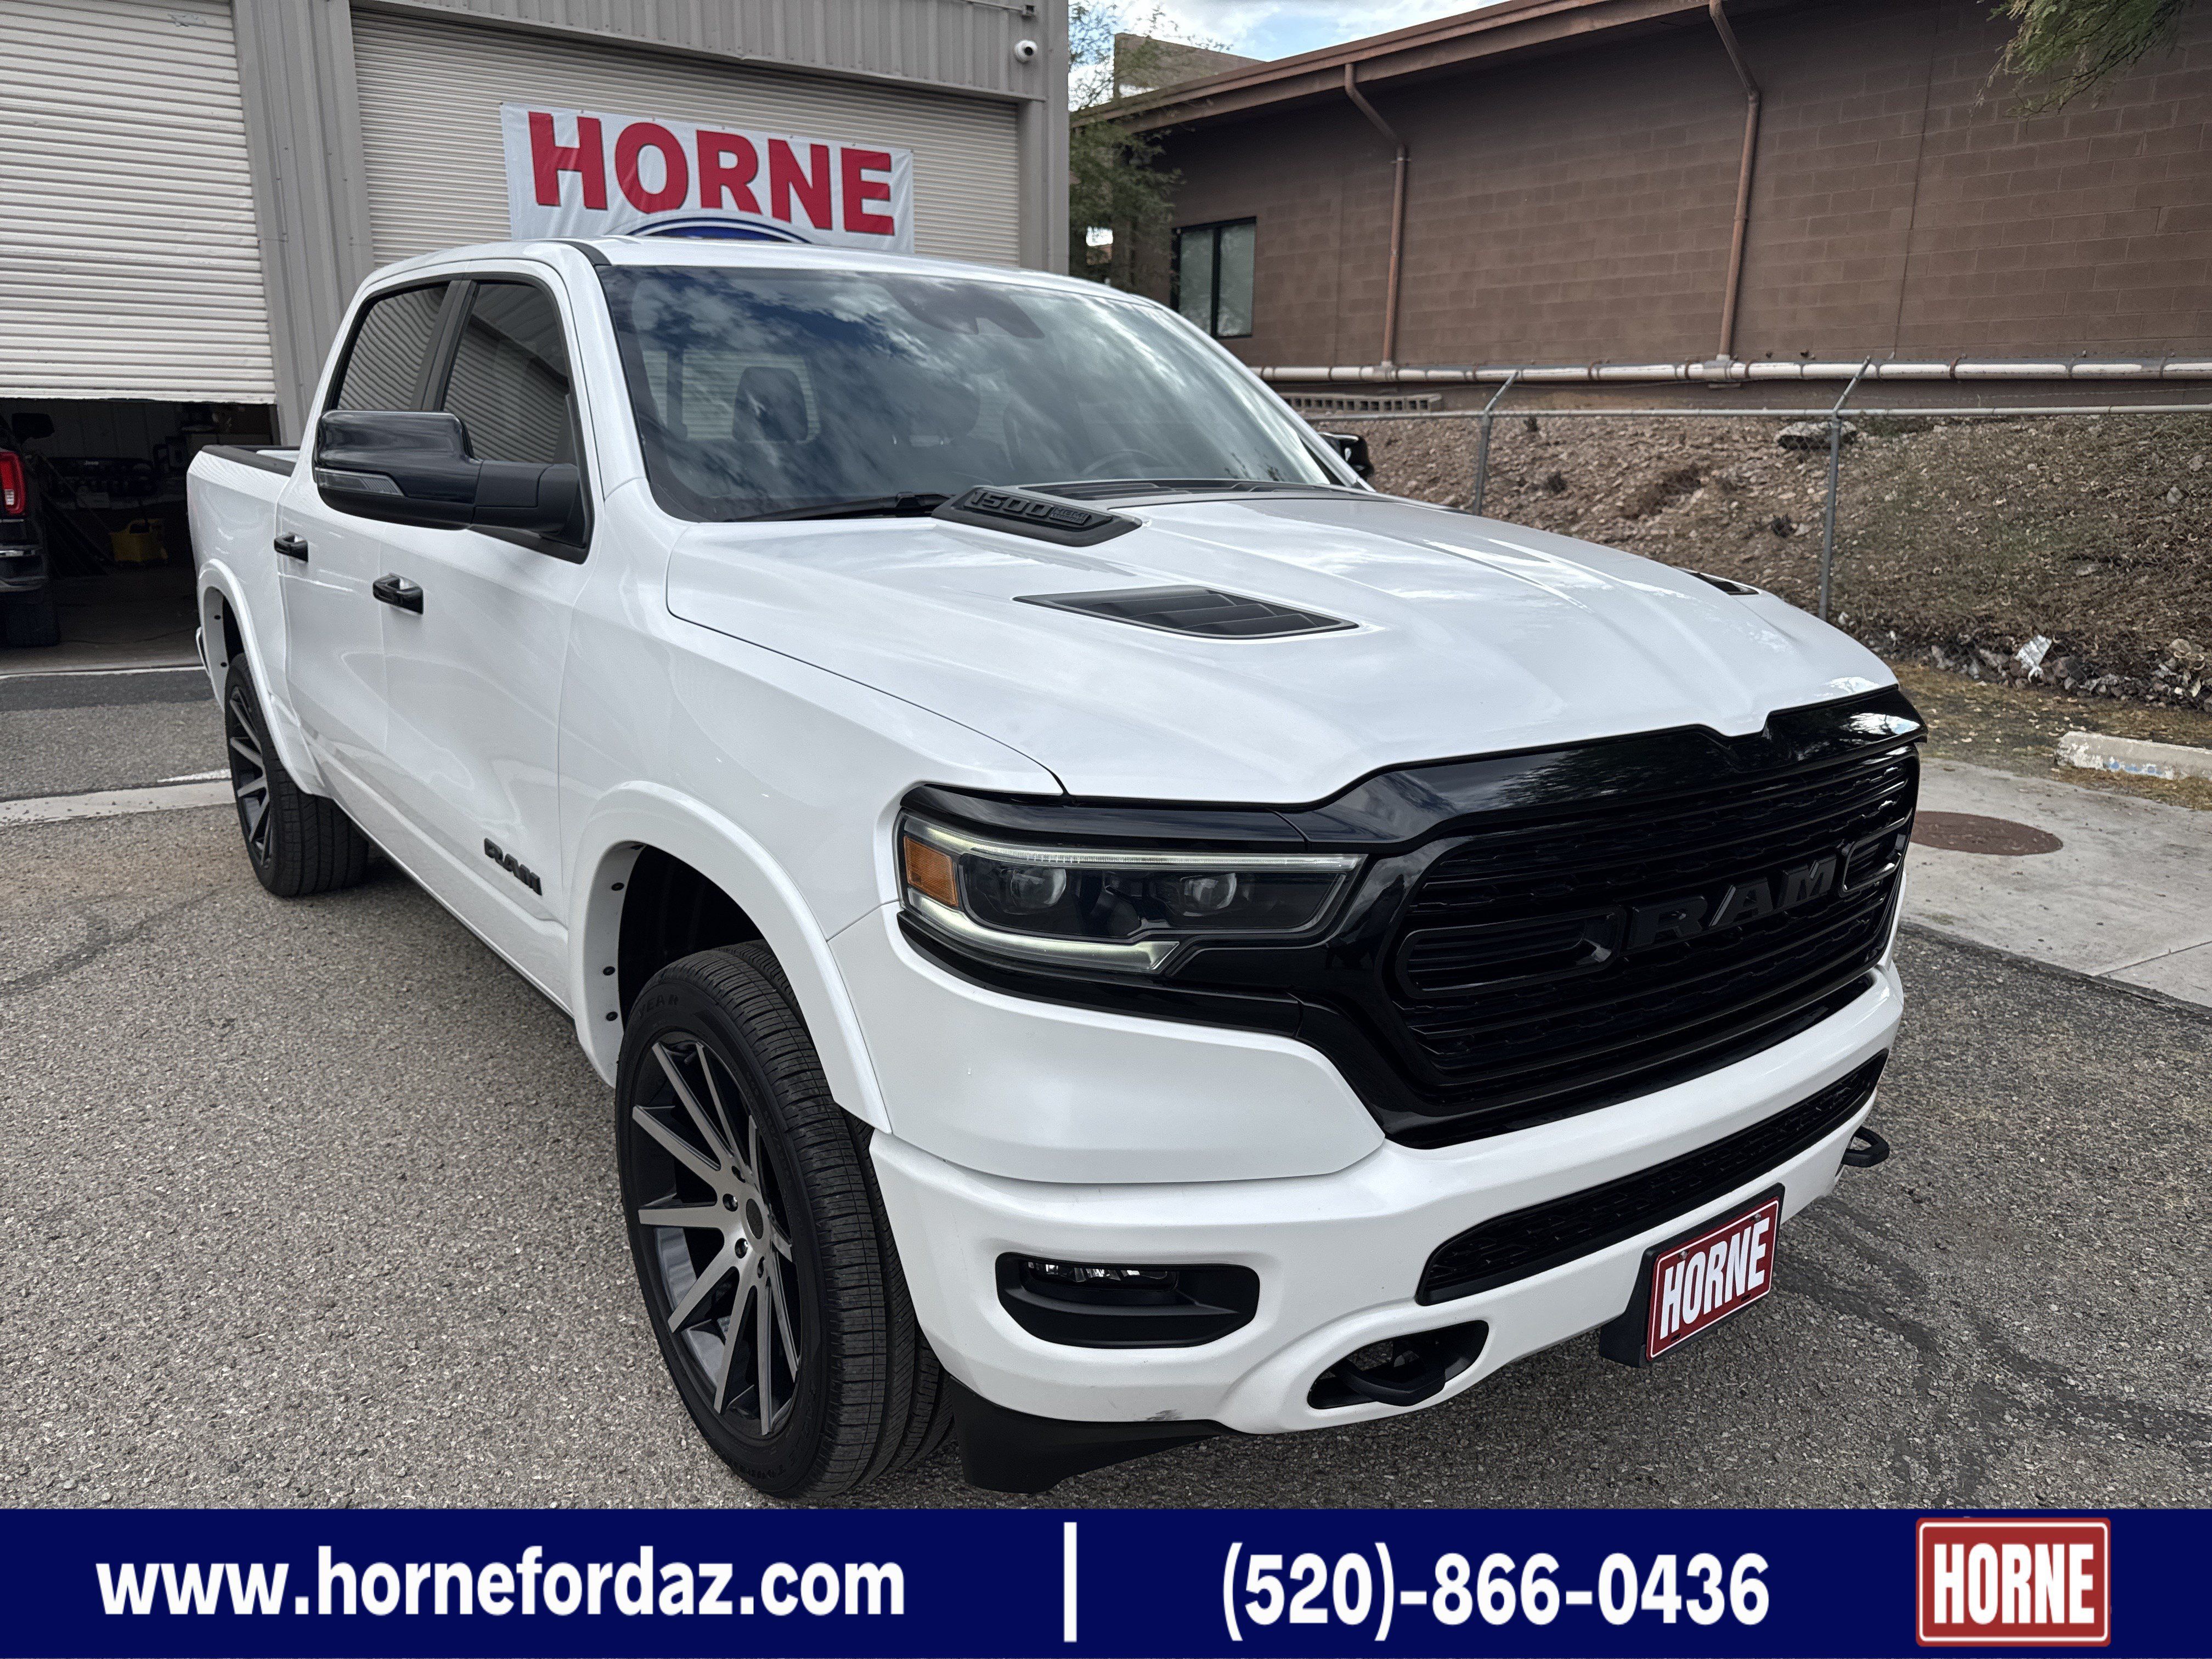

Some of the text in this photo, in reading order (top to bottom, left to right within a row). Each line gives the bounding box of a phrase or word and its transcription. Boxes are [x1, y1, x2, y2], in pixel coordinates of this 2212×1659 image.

[528, 111, 895, 235] HORNE
[970, 492, 1052, 517] 1500
[484, 838, 542, 896] RAM
[1626, 855, 1838, 951] RAM
[1660, 1217, 1770, 1340] HORNE
